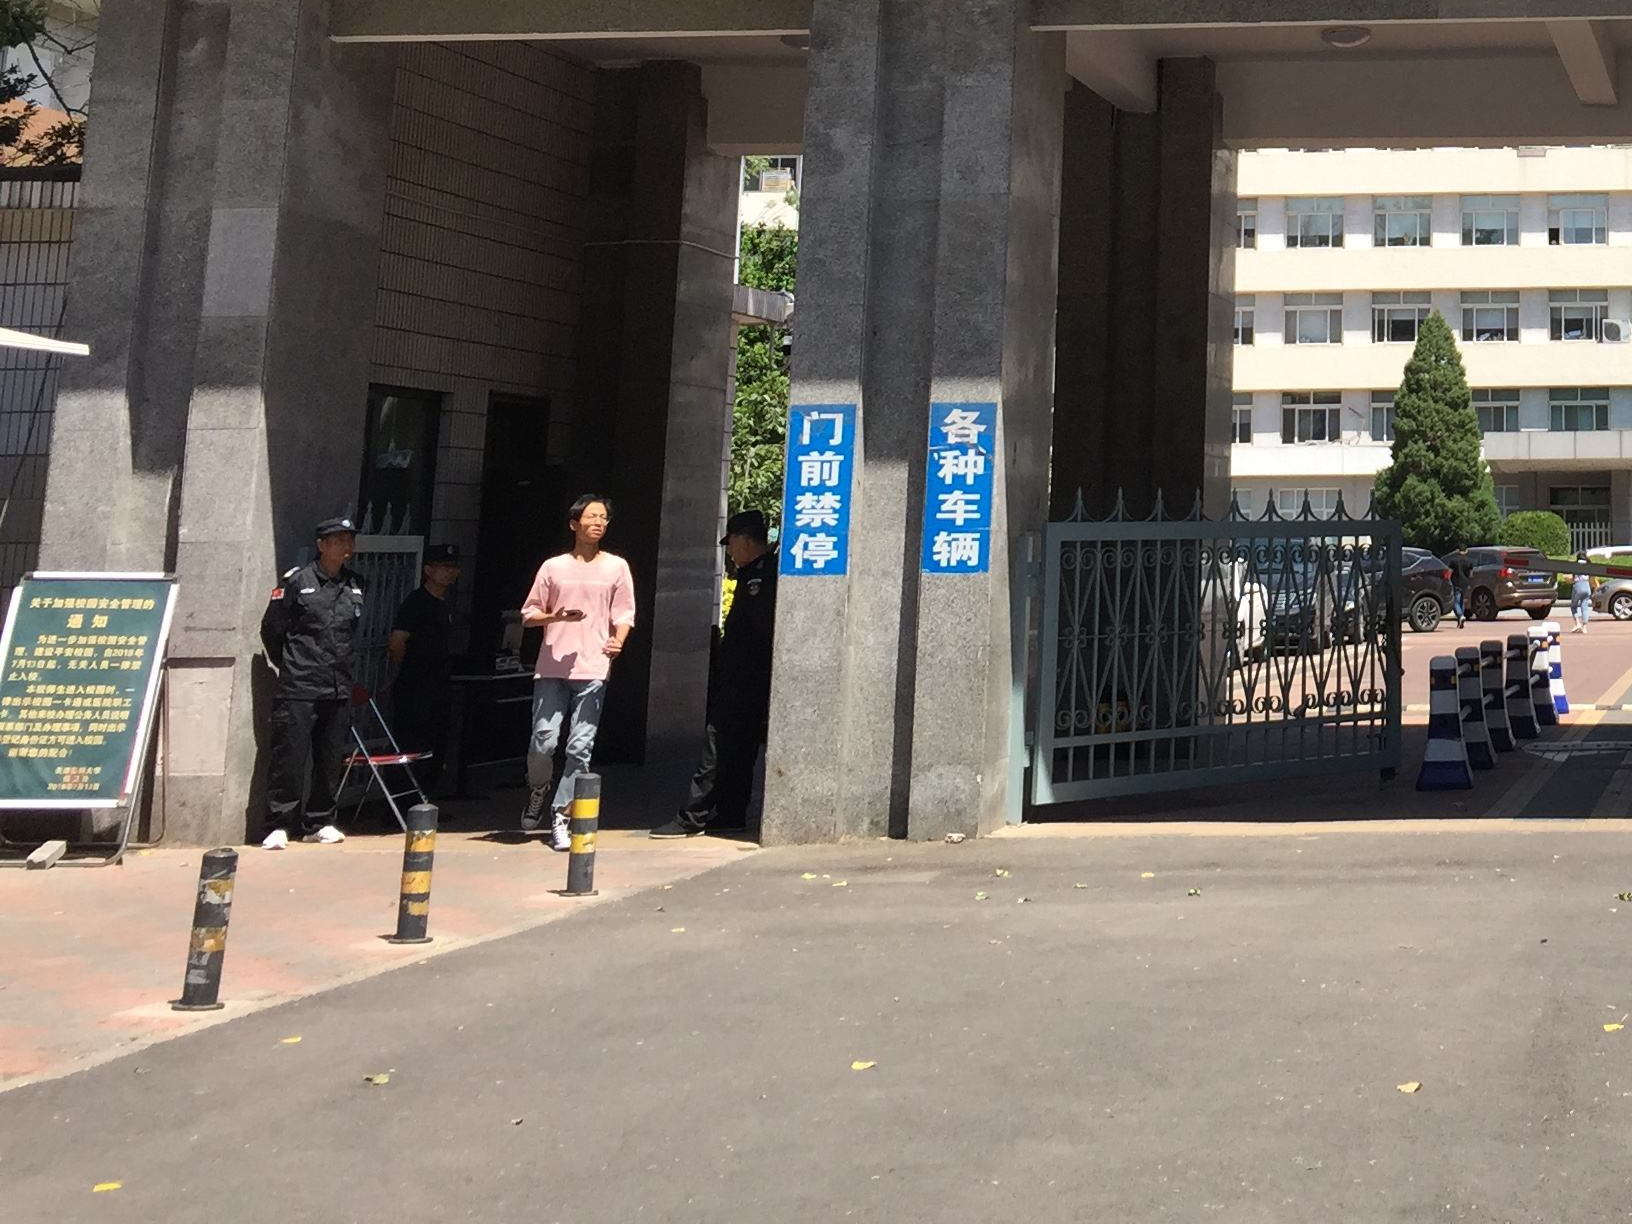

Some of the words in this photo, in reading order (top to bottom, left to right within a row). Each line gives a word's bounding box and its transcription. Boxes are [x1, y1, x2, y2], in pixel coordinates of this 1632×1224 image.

[790, 411, 844, 569] 门前禁停
[932, 408, 987, 568] 各种车辆
[30, 598, 155, 610] 关于加强校园安全管理的
[66, 614, 109, 629] 通知
